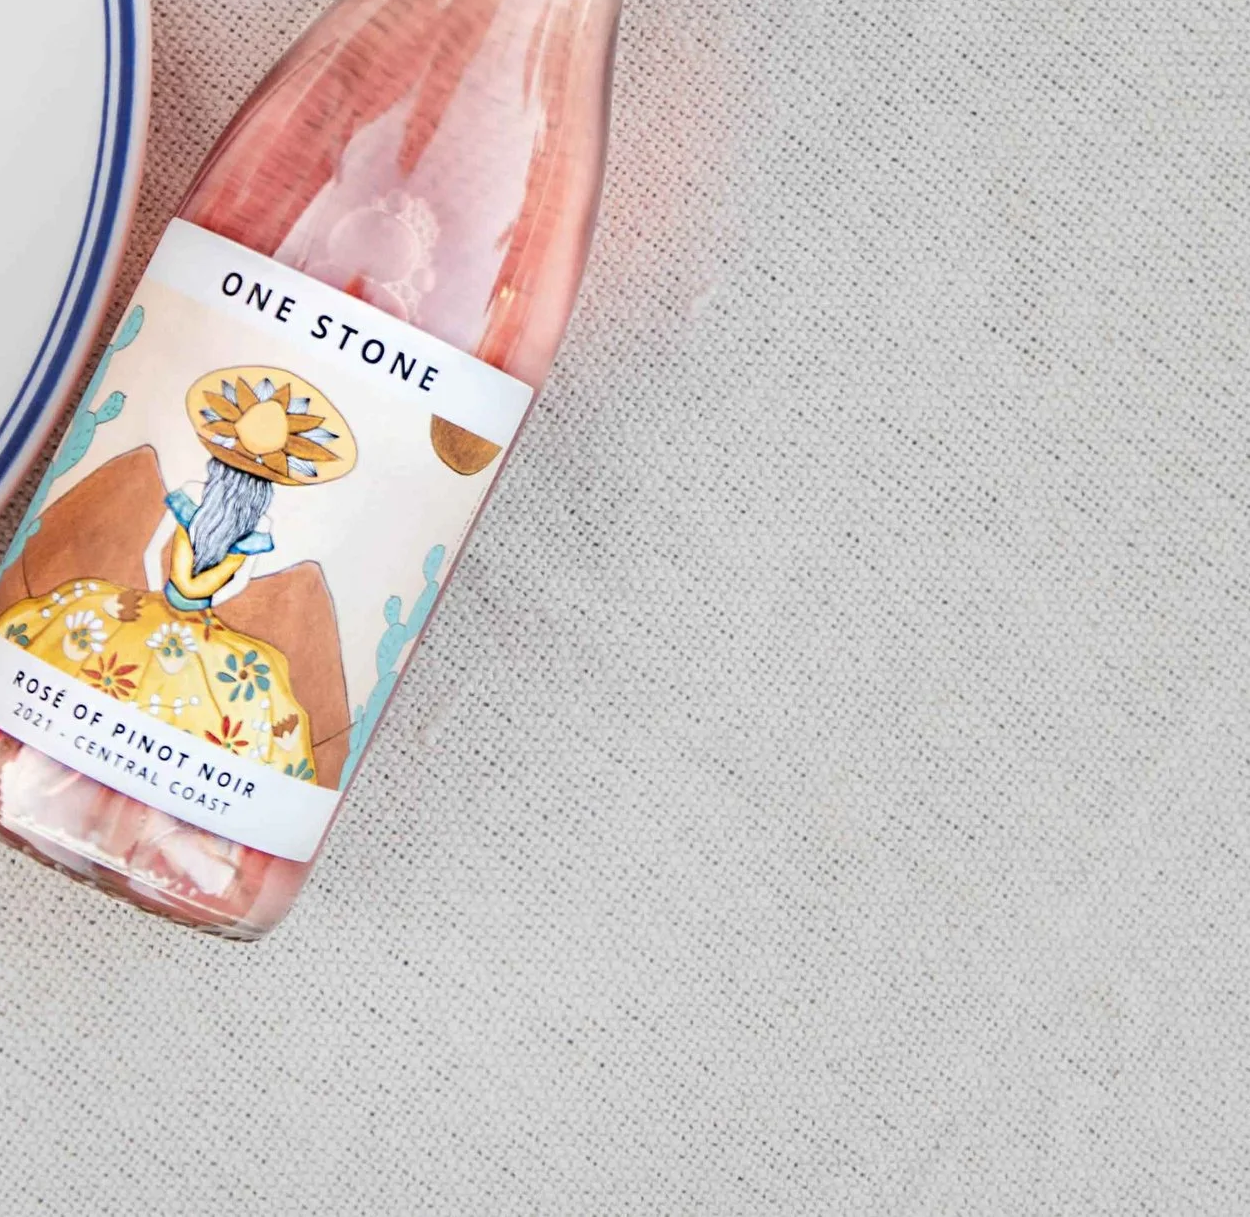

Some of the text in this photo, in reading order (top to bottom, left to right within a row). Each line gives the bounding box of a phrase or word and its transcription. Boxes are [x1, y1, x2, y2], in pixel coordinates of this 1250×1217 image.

[221, 272, 439, 393] ONE STONE
[13, 670, 257, 799] ROSÉ OF PINOT NOIR
[13, 701, 54, 732] 2021
[73, 735, 158, 788] CENTRAL
[169, 780, 233, 816] COAST
